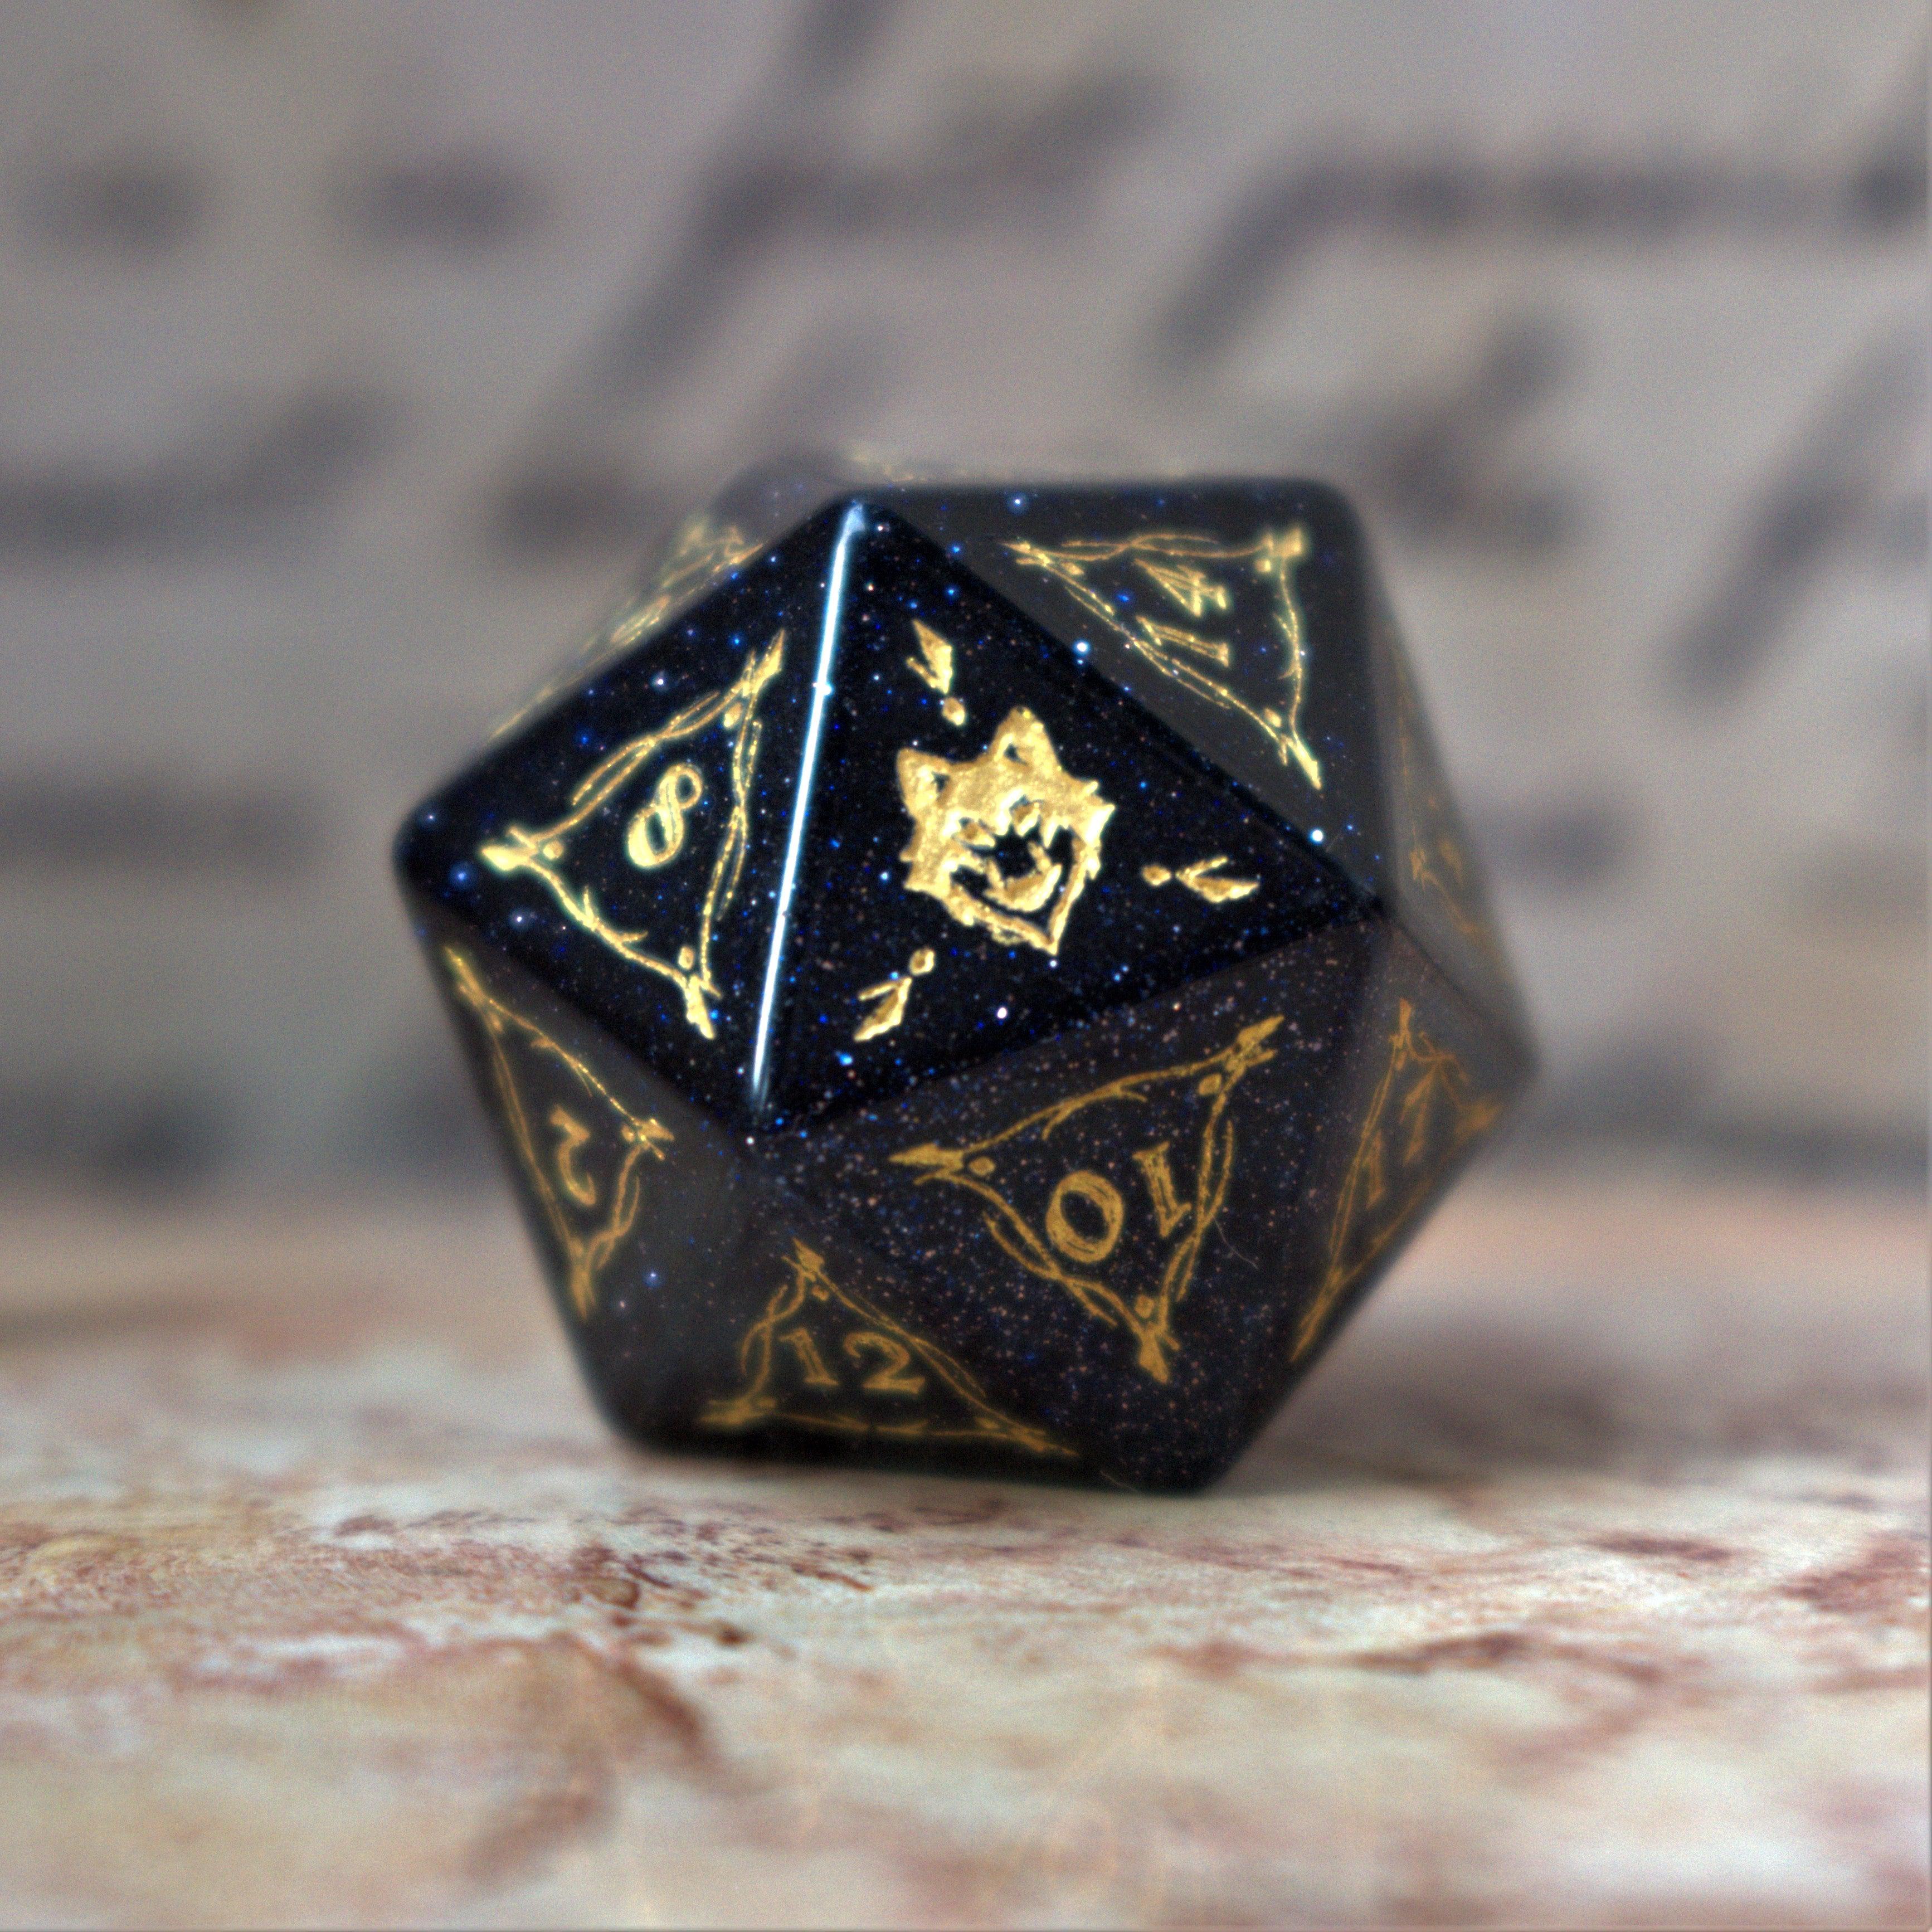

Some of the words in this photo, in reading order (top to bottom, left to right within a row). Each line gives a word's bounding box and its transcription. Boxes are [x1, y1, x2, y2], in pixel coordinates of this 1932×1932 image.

[1135, 559, 1228, 666] 14
[627, 762, 702, 868] 8
[548, 1106, 596, 1203] 2
[1046, 1142, 1191, 1263] 10
[781, 1328, 926, 1394] 12
